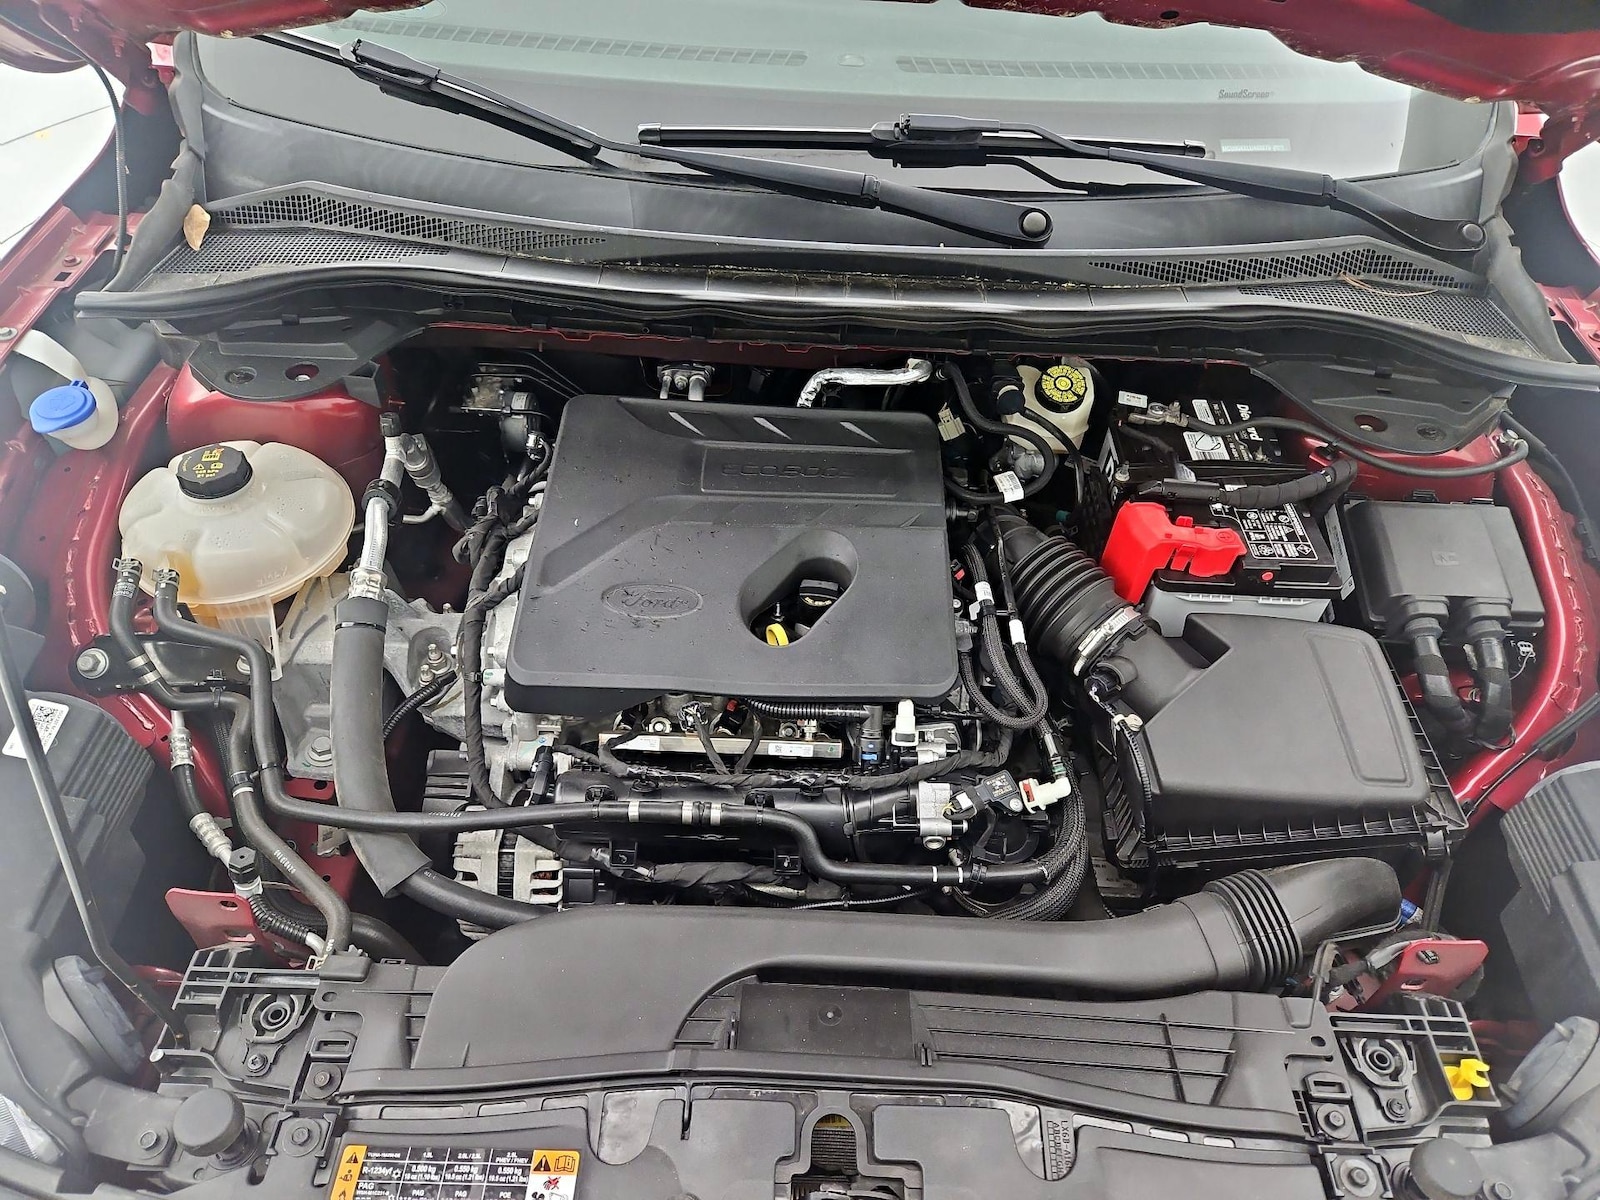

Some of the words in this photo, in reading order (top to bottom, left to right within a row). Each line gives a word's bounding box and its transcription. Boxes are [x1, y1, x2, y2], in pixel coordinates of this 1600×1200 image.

[1236, 403, 1263, 441] Dierd
[721, 462, 872, 479] ECOBOOS
[362, 1165, 393, 1176] R-1234yf
[428, 1165, 437, 1175] kg
[470, 1166, 479, 1175] kg
[514, 1167, 523, 1177] kg
[357, 1182, 375, 1190] PAG
[411, 1189, 425, 1197] PAG
[454, 1190, 468, 1198] PAG
